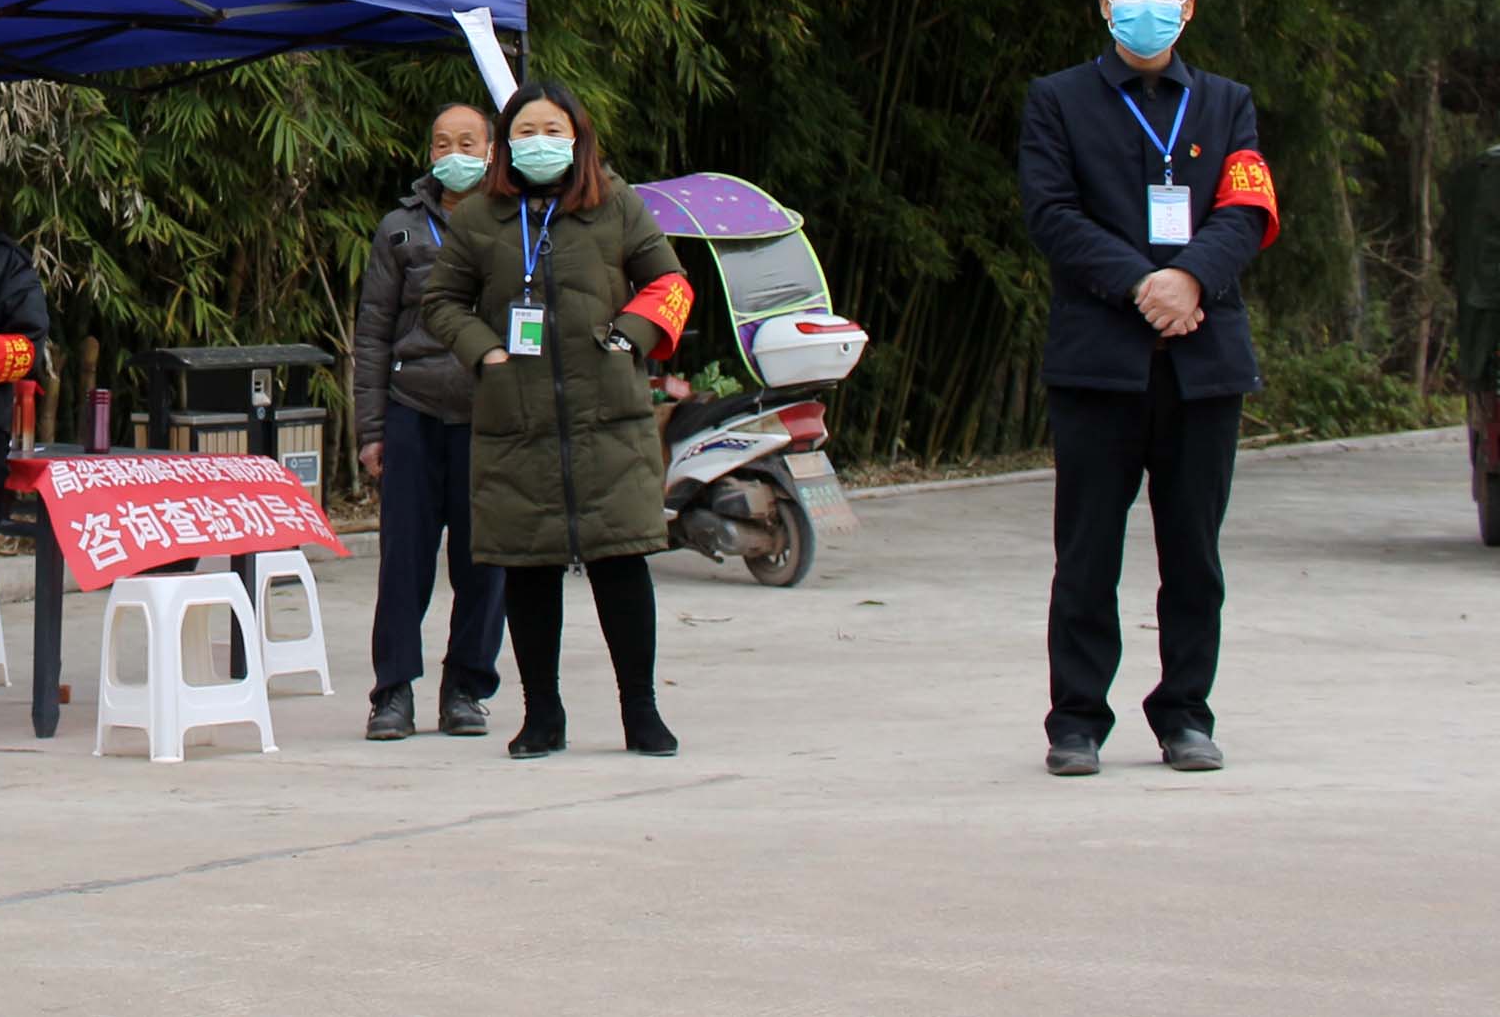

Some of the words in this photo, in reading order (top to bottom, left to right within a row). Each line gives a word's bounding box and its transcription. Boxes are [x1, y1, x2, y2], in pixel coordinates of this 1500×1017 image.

[70, 492, 335, 571] 咨询查验劝导点
